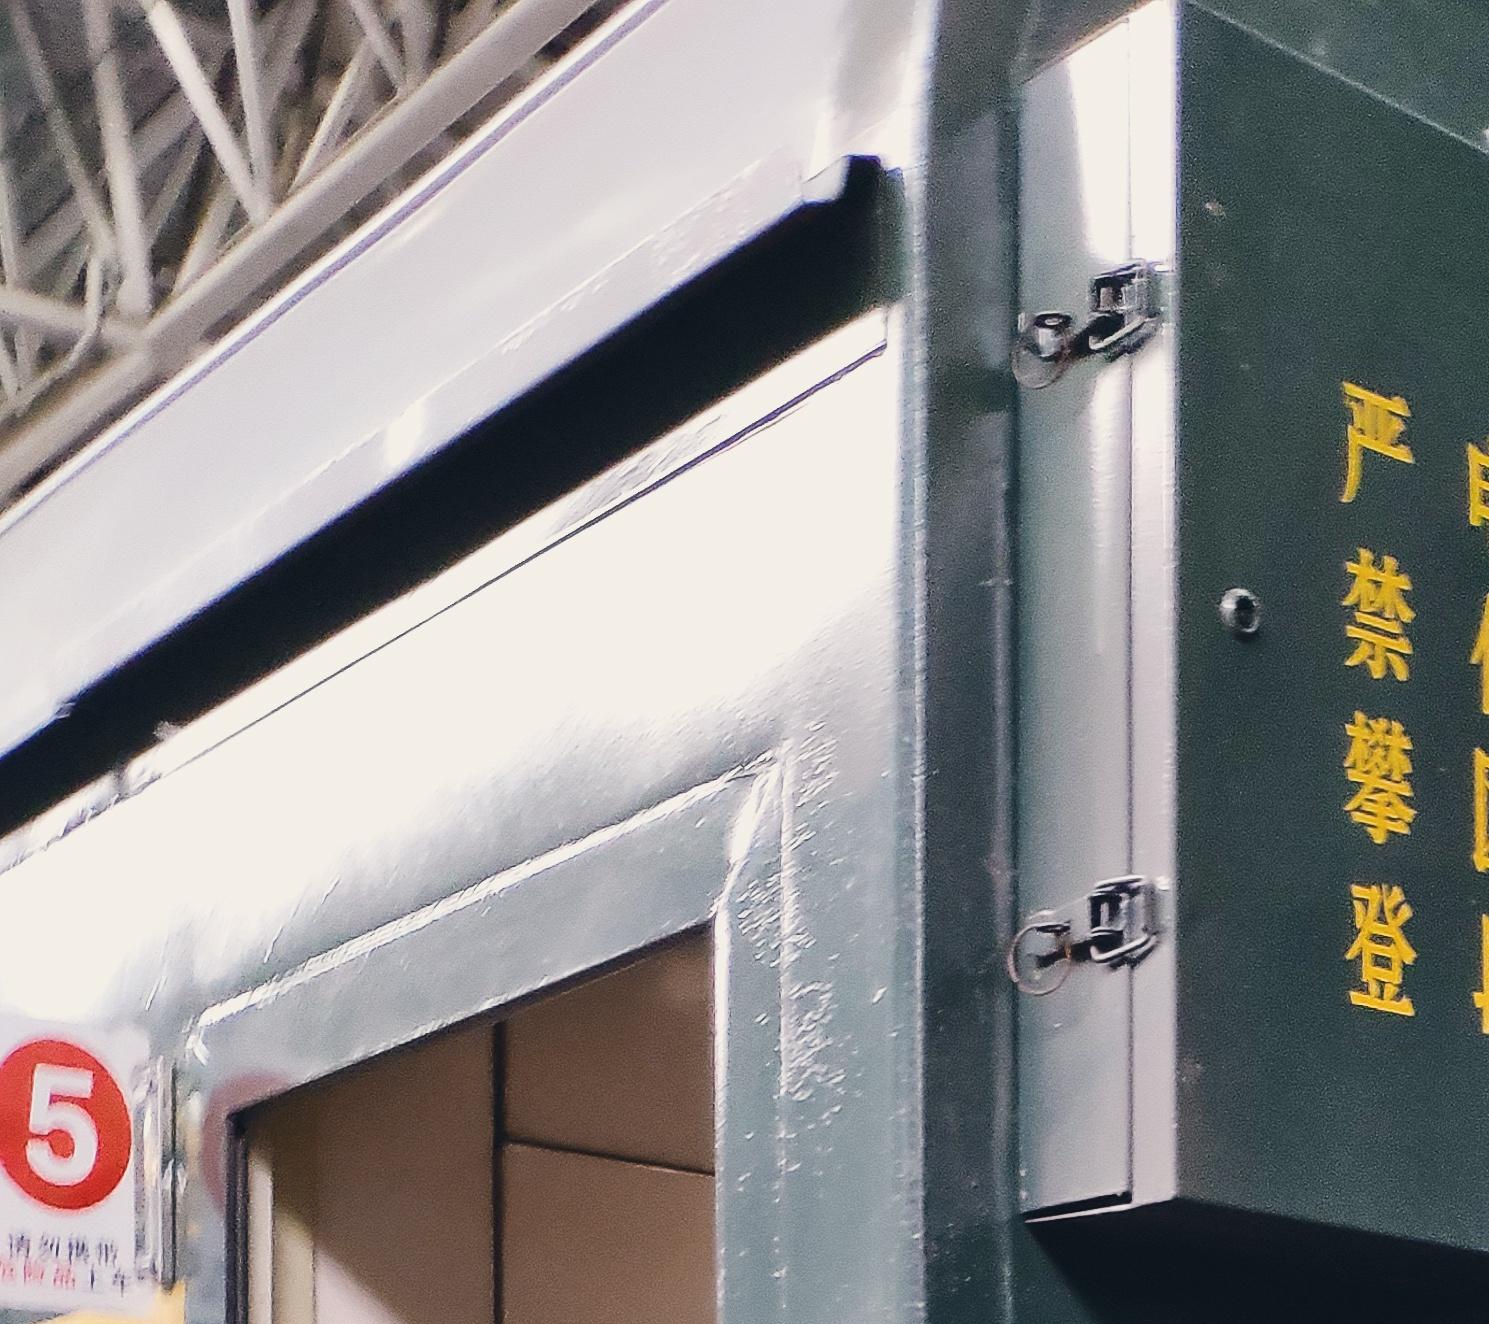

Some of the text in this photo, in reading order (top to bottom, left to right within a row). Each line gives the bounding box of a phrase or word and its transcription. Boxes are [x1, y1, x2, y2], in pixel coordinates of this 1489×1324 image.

[1341, 380, 1417, 1016] 严禁攀登
[25, 1062, 99, 1187] 5
